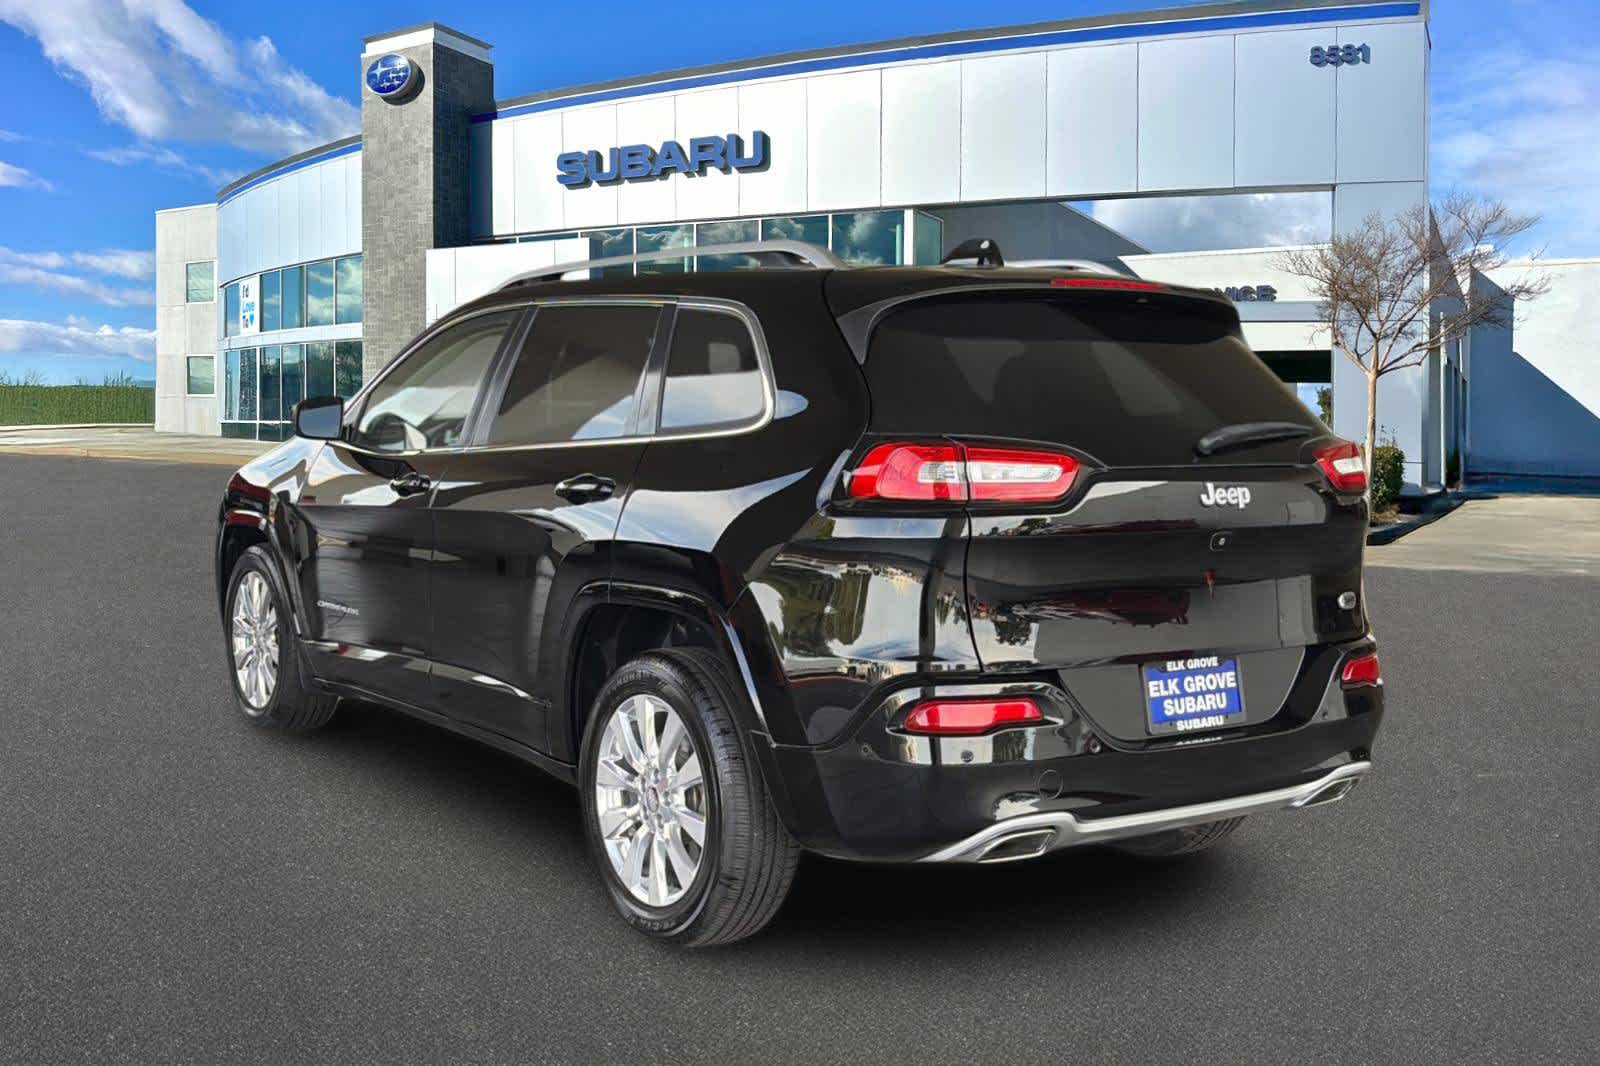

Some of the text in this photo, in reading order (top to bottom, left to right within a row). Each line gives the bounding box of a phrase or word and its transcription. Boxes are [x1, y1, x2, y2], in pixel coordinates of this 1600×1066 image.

[556, 130, 771, 190] SUBARU
[1200, 482, 1251, 509] Jeep
[1166, 656, 1219, 672] ELK GROVE
[1148, 671, 1237, 698] ELK GROVE
[1163, 692, 1227, 717] SUBARU
[1176, 714, 1225, 732] SUBARU
